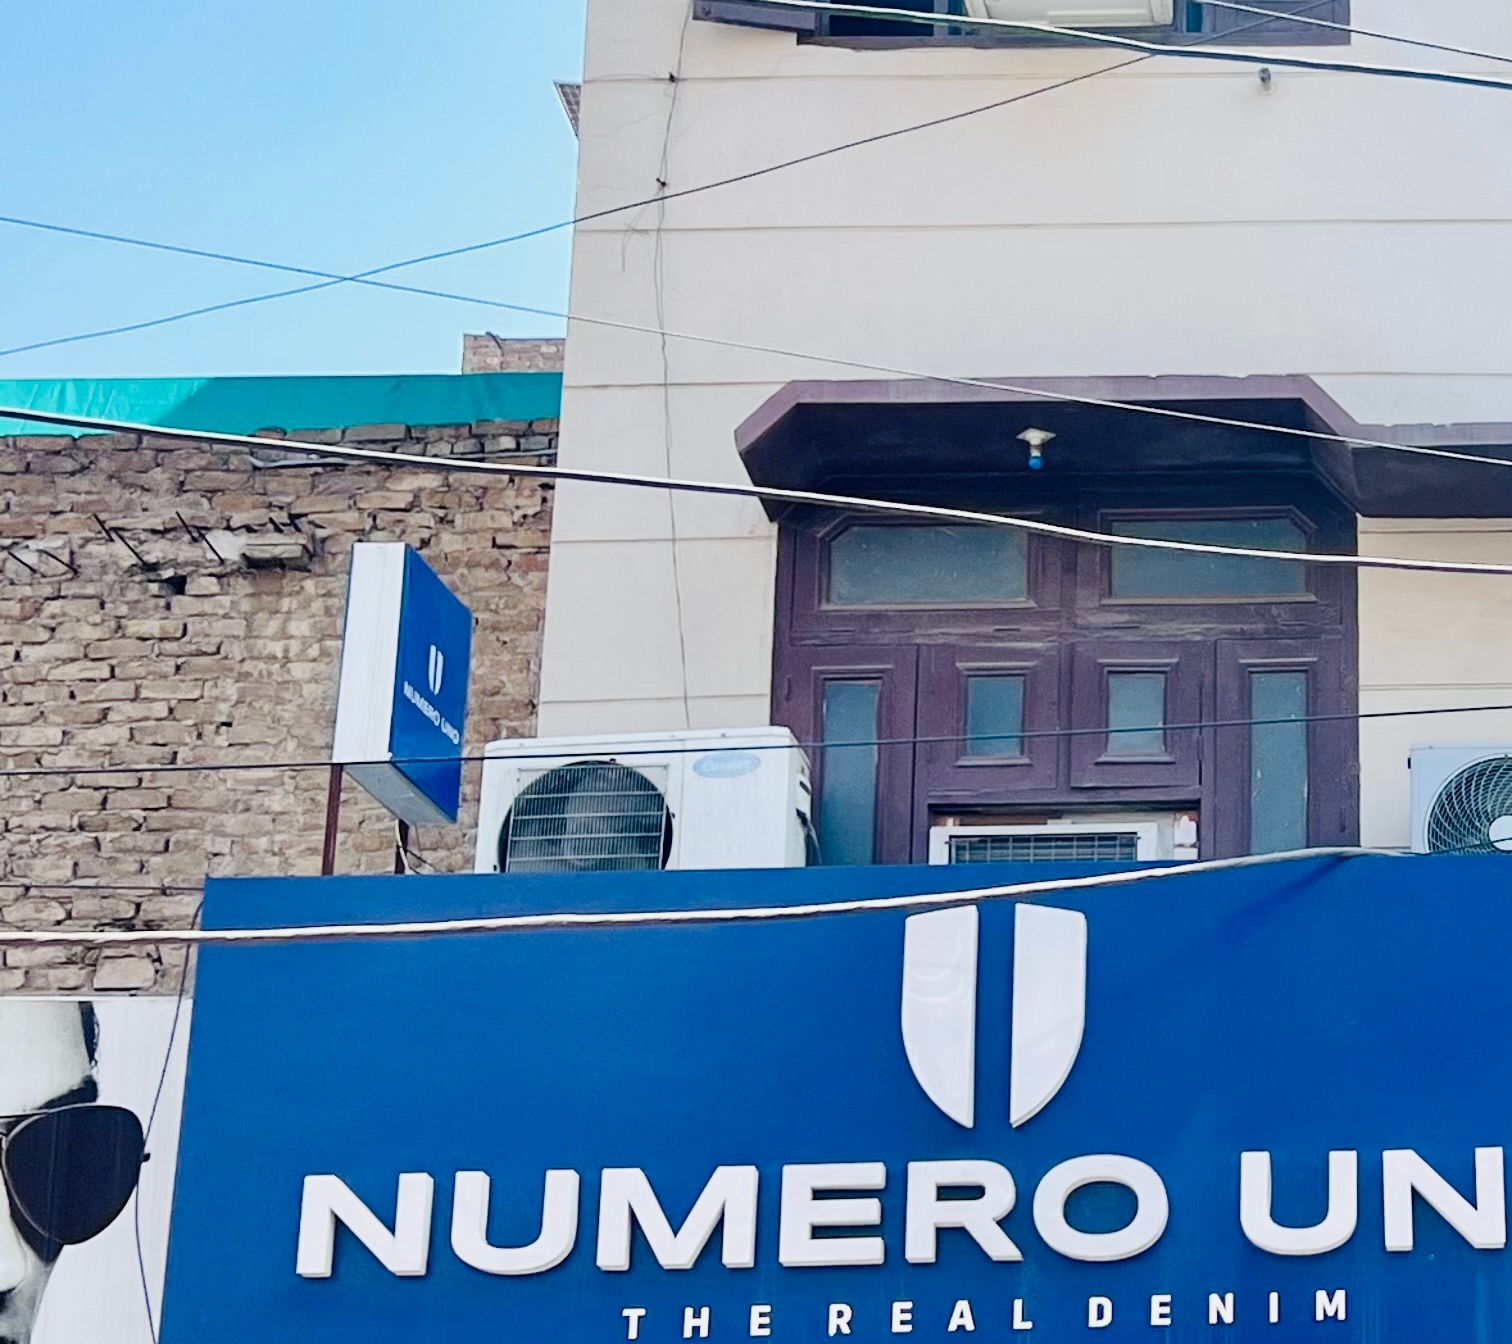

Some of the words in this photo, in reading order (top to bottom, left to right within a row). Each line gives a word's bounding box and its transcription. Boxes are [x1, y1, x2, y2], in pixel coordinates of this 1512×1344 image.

[296, 1155, 1168, 1278] NUMERO
[622, 1307, 772, 1341] THE
[828, 1299, 1034, 1337] REAL
[1088, 1289, 1347, 1330] DENIM
